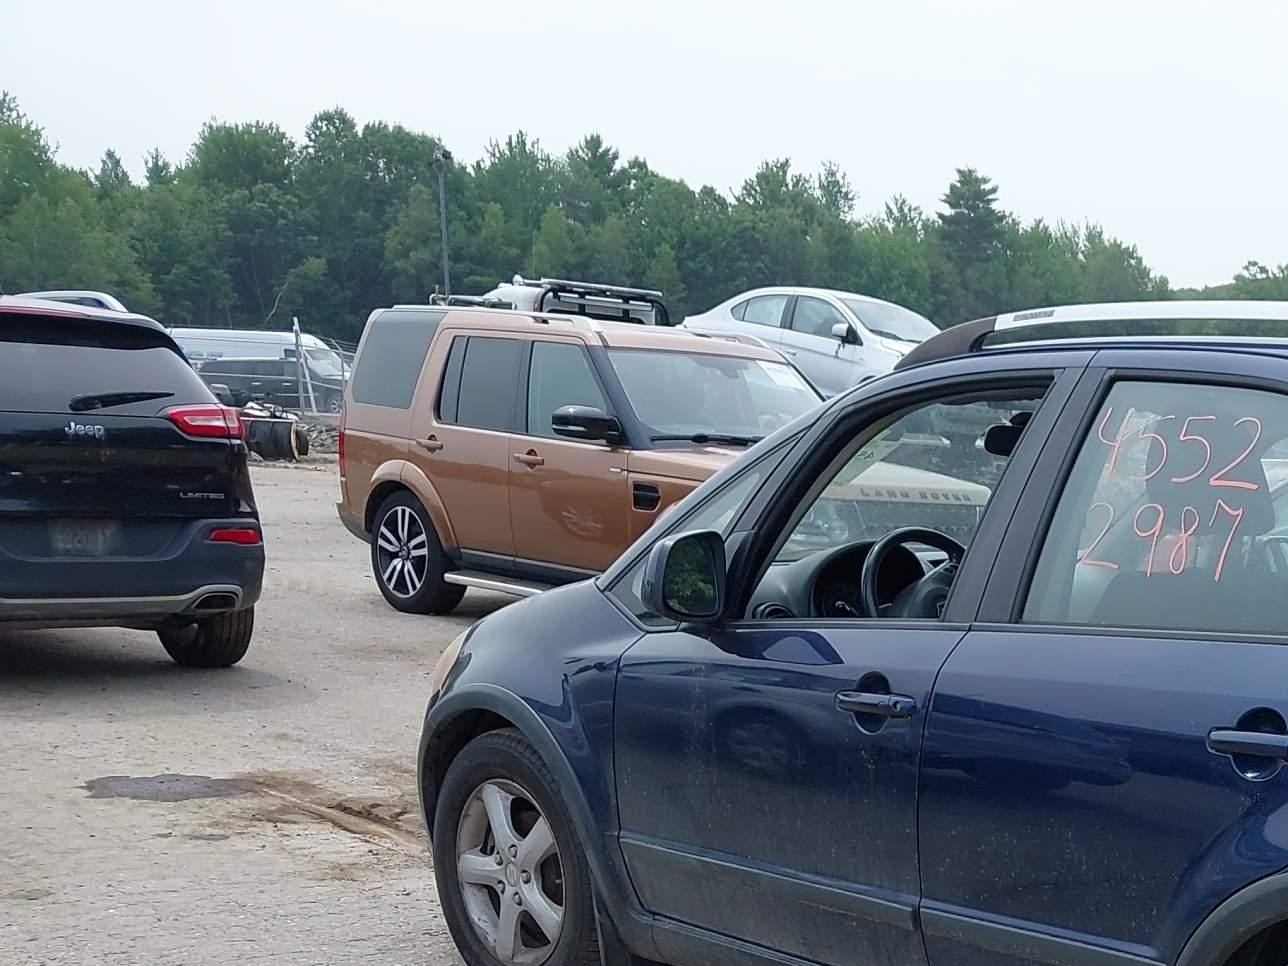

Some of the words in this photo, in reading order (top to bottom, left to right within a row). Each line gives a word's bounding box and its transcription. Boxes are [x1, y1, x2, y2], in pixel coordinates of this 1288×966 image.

[64, 421, 105, 438] Jeep
[1098, 407, 1262, 490] 4552
[1080, 499, 1244, 582] 2987
